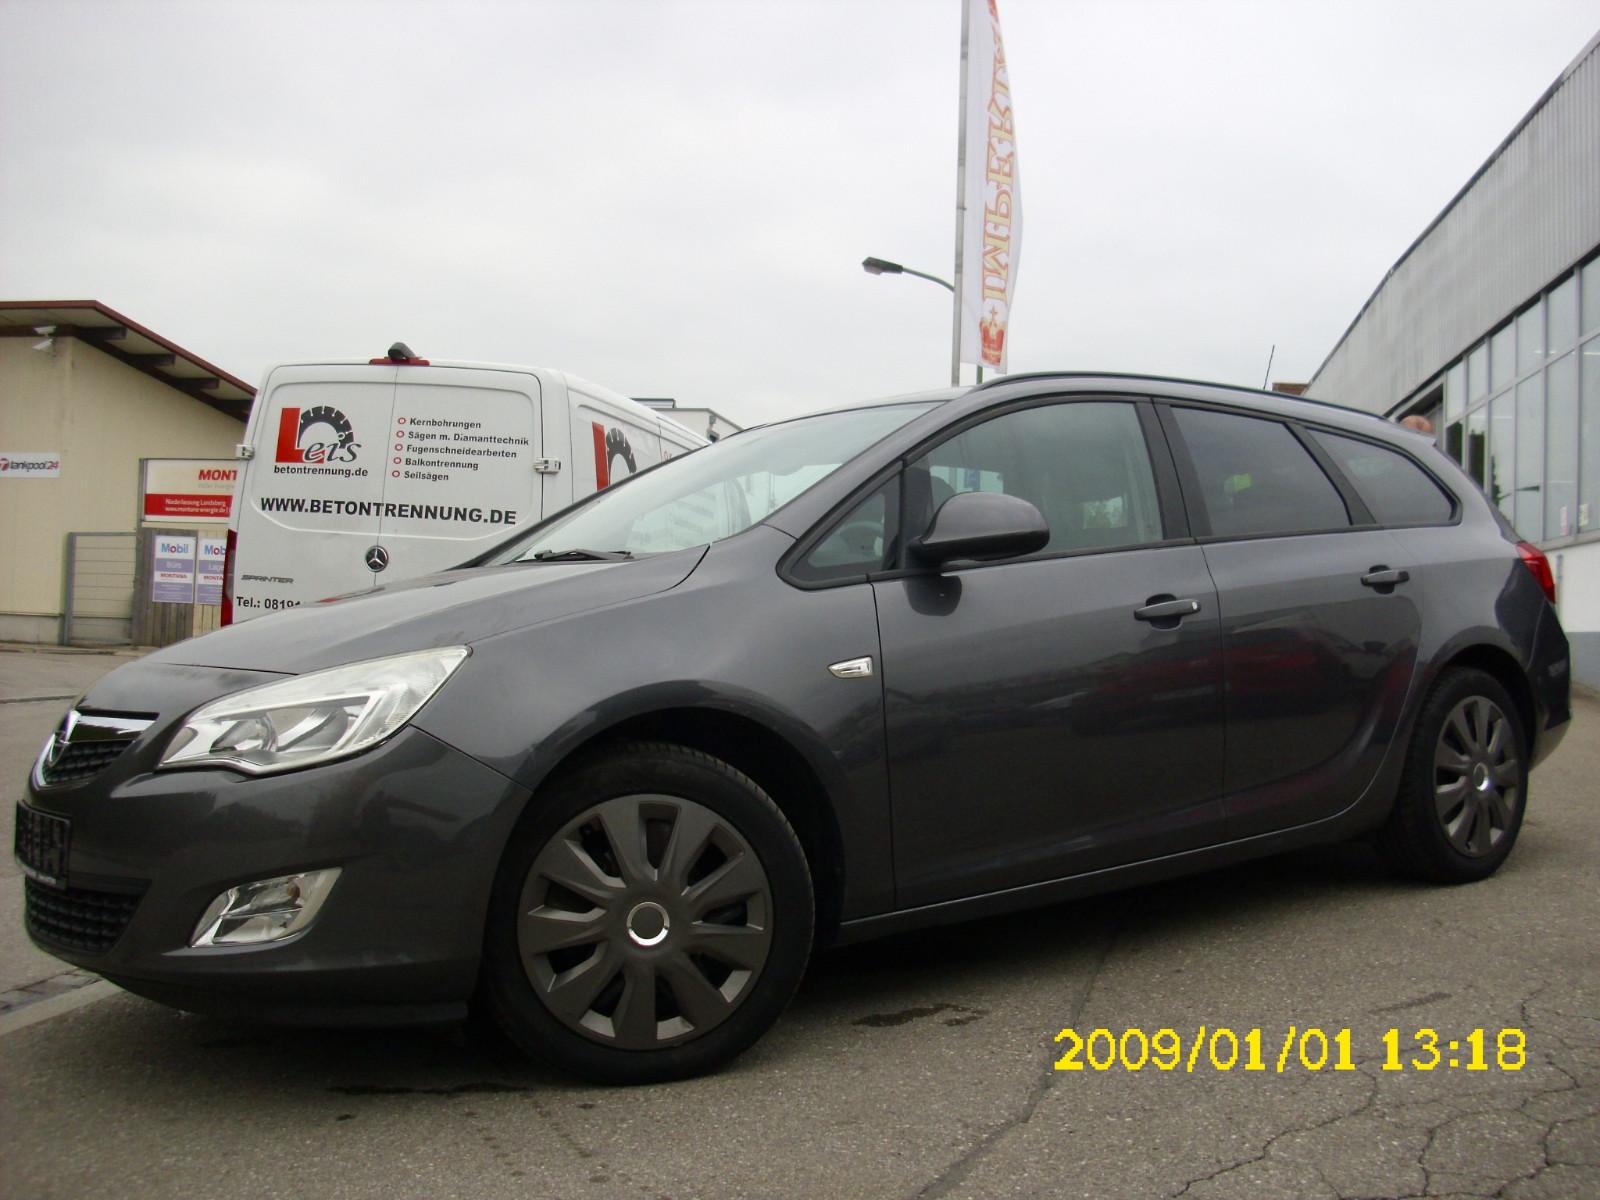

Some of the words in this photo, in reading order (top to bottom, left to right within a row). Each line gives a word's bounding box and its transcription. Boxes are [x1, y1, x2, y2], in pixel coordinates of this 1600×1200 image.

[409, 417, 482, 430] Kernbohrungen
[408, 430, 437, 442] Sägen
[453, 433, 529, 446] Diamanttechnik
[406, 444, 517, 458] Fugenschneidearbeiten
[405, 457, 479, 471] Balkontrennung
[273, 465, 369, 478] betontrennung.de
[403, 471, 449, 482] Seilsägen
[260, 497, 517, 525] WWW.BETONTRENNUNG.DE
[161, 543, 189, 554] Mobil
[236, 595, 260, 608] Tel.:
